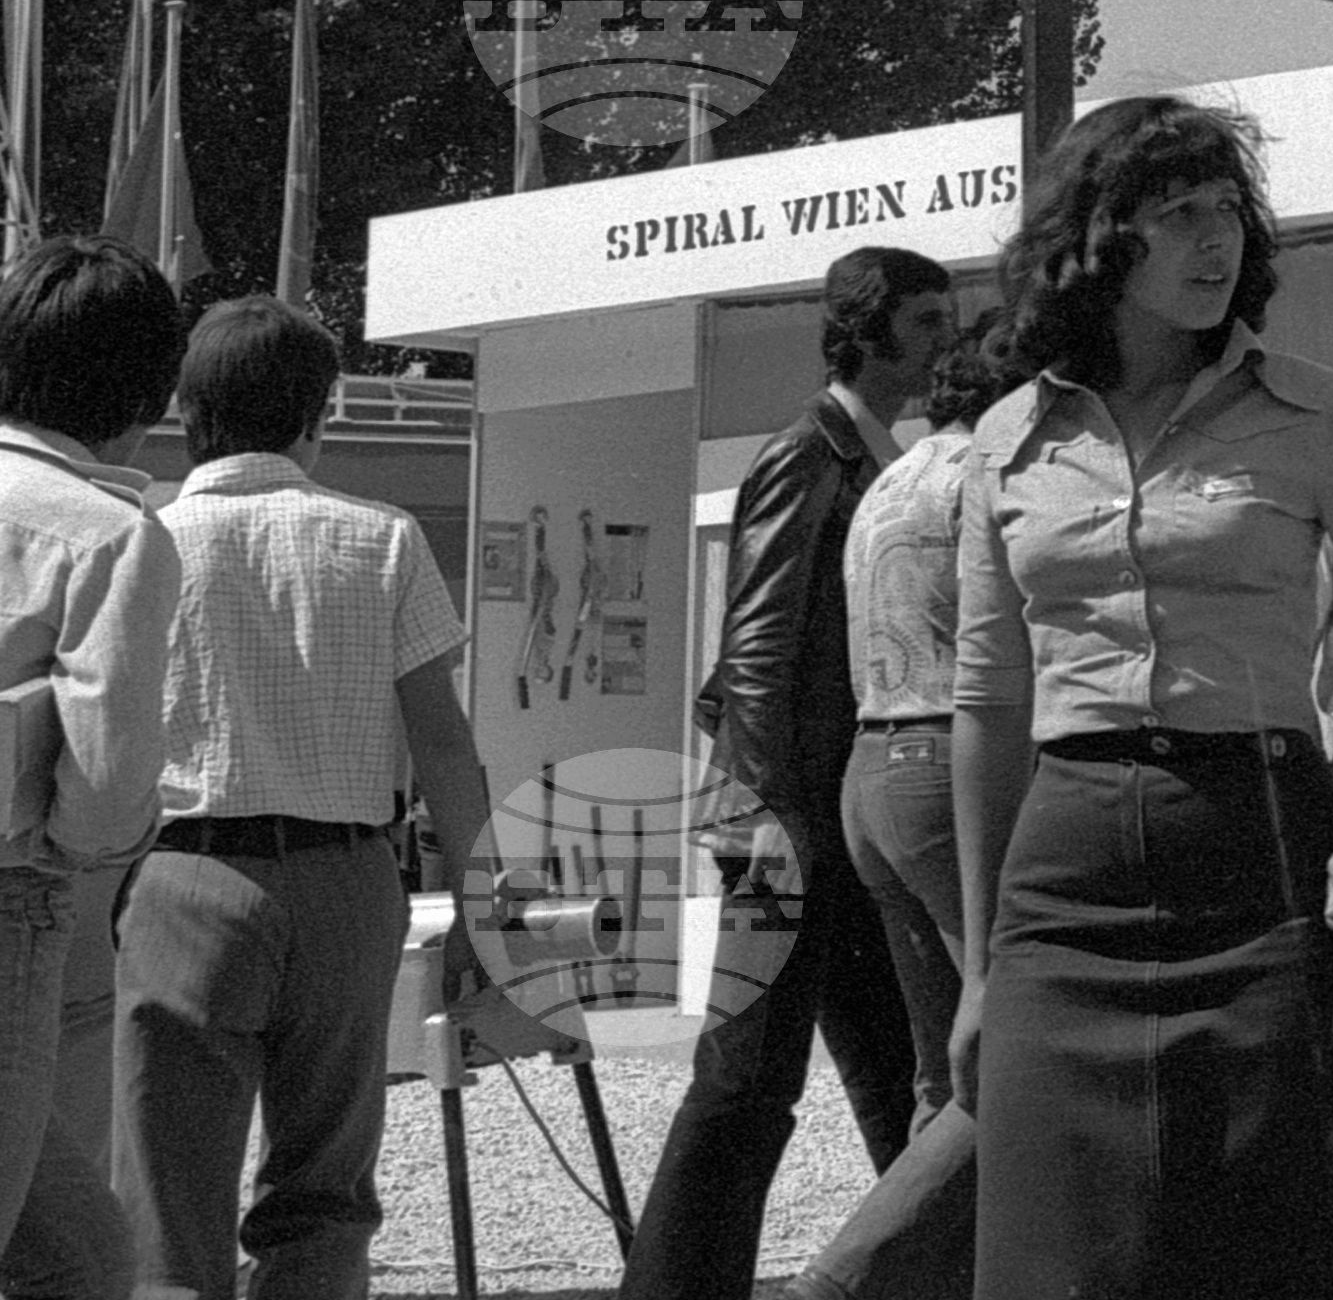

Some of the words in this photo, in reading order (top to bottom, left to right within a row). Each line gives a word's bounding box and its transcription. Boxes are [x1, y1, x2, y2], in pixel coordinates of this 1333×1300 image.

[606, 204, 765, 261] SPIRAL
[781, 180, 907, 236] WIEN
[925, 165, 1018, 214] AUS
